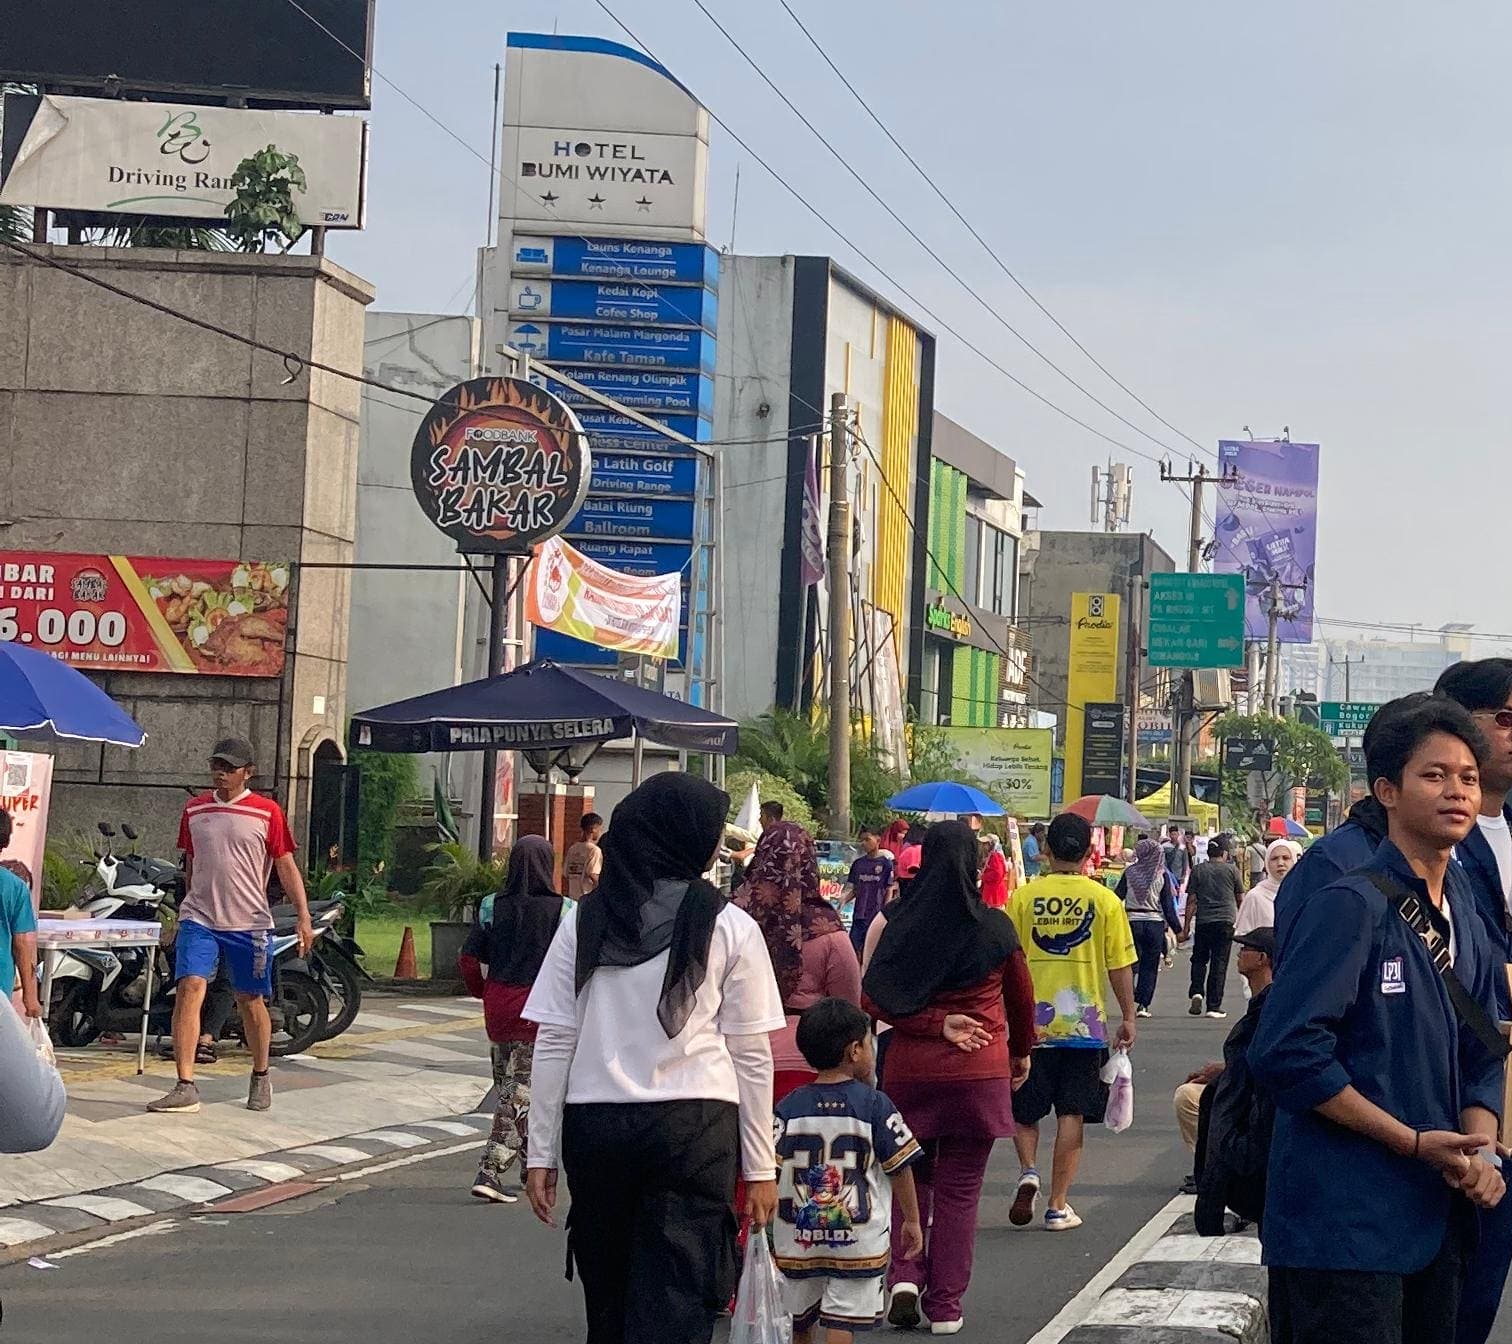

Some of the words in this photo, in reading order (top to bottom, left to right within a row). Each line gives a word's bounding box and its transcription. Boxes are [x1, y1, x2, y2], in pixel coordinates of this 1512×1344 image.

[554, 140, 646, 160] HOTEL
[108, 165, 187, 192] Driving
[193, 171, 250, 191] Ran
[521, 162, 580, 180] BUMI
[585, 164, 676, 186] WIYATA
[623, 243, 673, 256] Kenanga
[581, 262, 630, 275] Kenanga
[634, 265, 677, 278] Lounge
[597, 286, 629, 297] Kedai
[632, 287, 659, 299] Kopi
[595, 307, 627, 319] Cofee
[630, 308, 658, 321] Shop
[561, 326, 590, 337] Pasar
[594, 328, 631, 339] Malam
[633, 330, 690, 343] Margonda
[583, 349, 615, 362] Kafe
[619, 351, 666, 365] Taman
[598, 370, 639, 385] Renang
[642, 373, 687, 387] Olimpik
[665, 397, 690, 408] Pool
[608, 413, 669, 428] Kebugan
[465, 427, 538, 443] FOODBANK
[588, 436, 624, 448] ness
[429, 445, 568, 489] SAMBAL
[604, 458, 639, 471] Latih
[643, 459, 674, 473] Golf
[592, 477, 634, 492] Driving
[637, 481, 672, 494] Range
[437, 486, 556, 532] BAKAR
[583, 500, 614, 512] Balai
[617, 501, 653, 516] Riung
[584, 520, 650, 536] Ballroom
[579, 541, 617, 555] Ruang
[619, 543, 654, 556] Rapat
[0, 563, 56, 584] BAR
[10, 585, 55, 601] DARI
[46, 651, 69, 660] AGI
[71, 651, 100, 662] MENU
[1340, 712, 1370, 721] Bogor
[450, 725, 491, 744] PRIA
[492, 724, 552, 744] PUNYA
[552, 718, 616, 740] SELERA
[0, 794, 39, 813] UPER
[1033, 897, 1083, 917] 50%
[1032, 917, 1060, 926] EBIH
[885, 1111, 913, 1146] 3
[793, 1227, 858, 1243] ROBLOX
